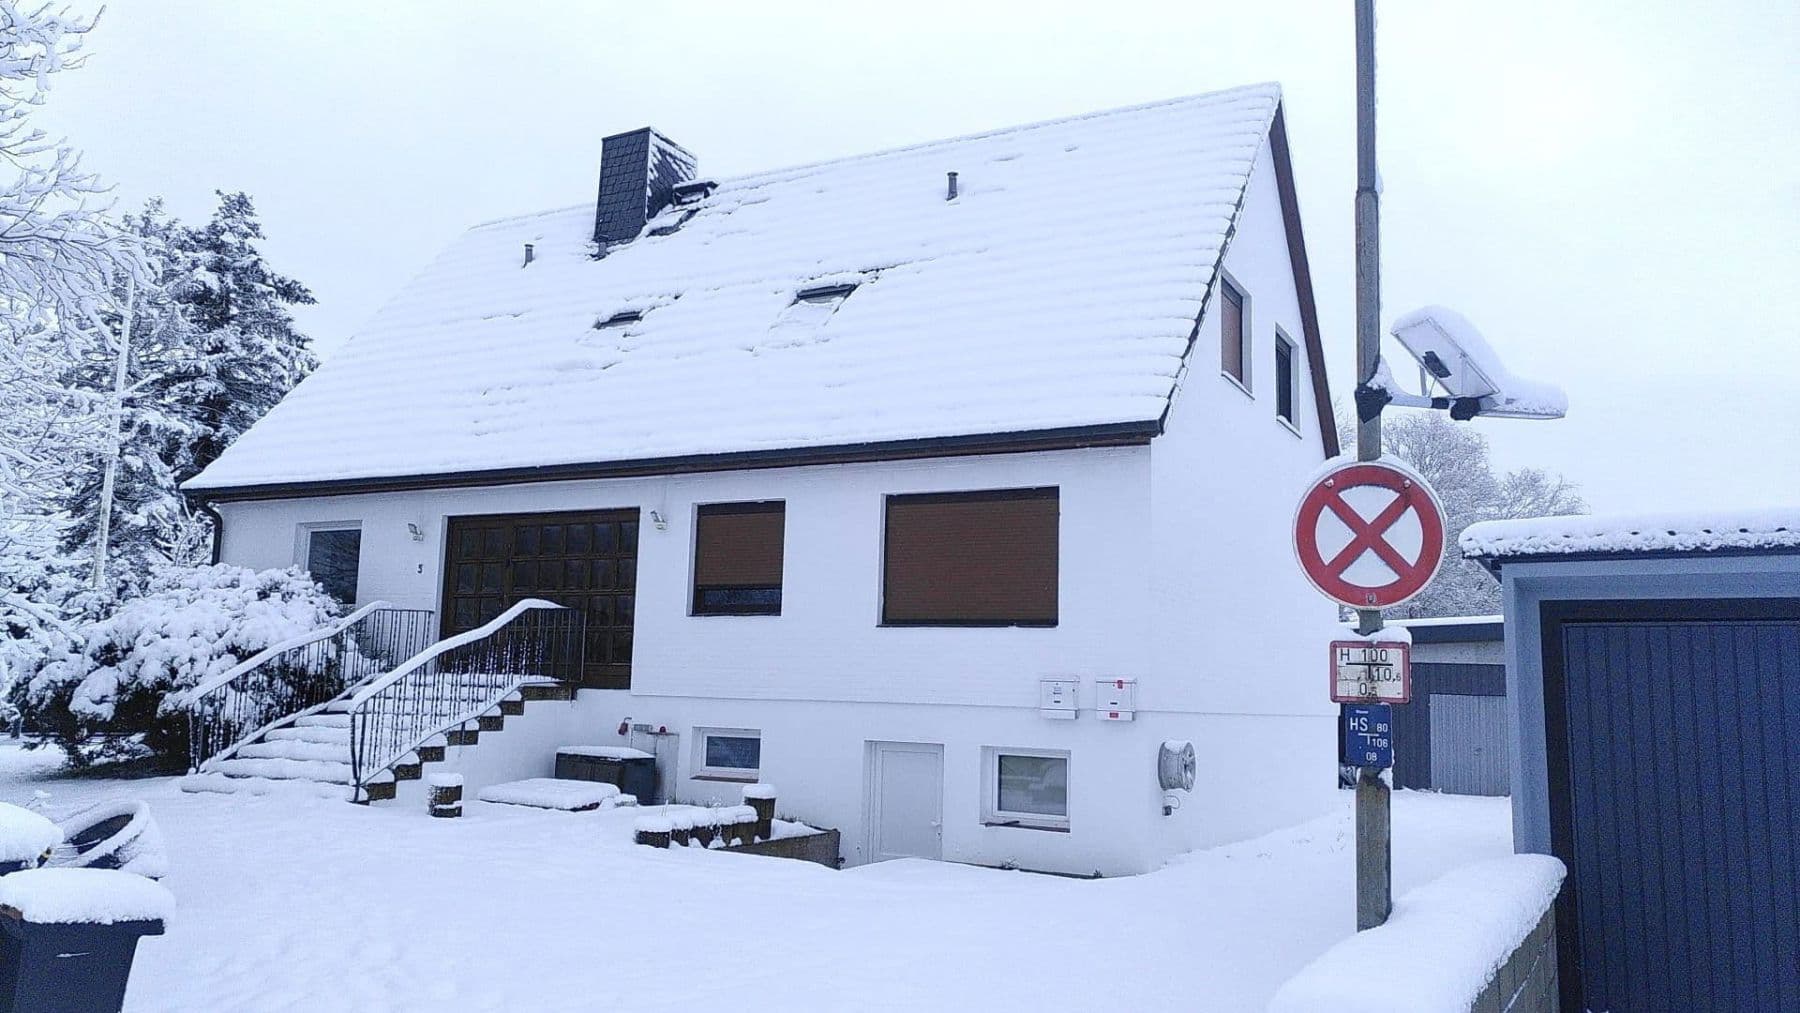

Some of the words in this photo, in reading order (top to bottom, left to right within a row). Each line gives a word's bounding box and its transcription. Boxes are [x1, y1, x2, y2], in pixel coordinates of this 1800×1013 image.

[1340, 648, 1350, 661] H
[1361, 649, 1388, 662] 100
[1350, 717, 1368, 732] HS
[1376, 723, 1388, 732] 80
[1372, 738, 1388, 748] 106
[1366, 752, 1377, 761] 08
